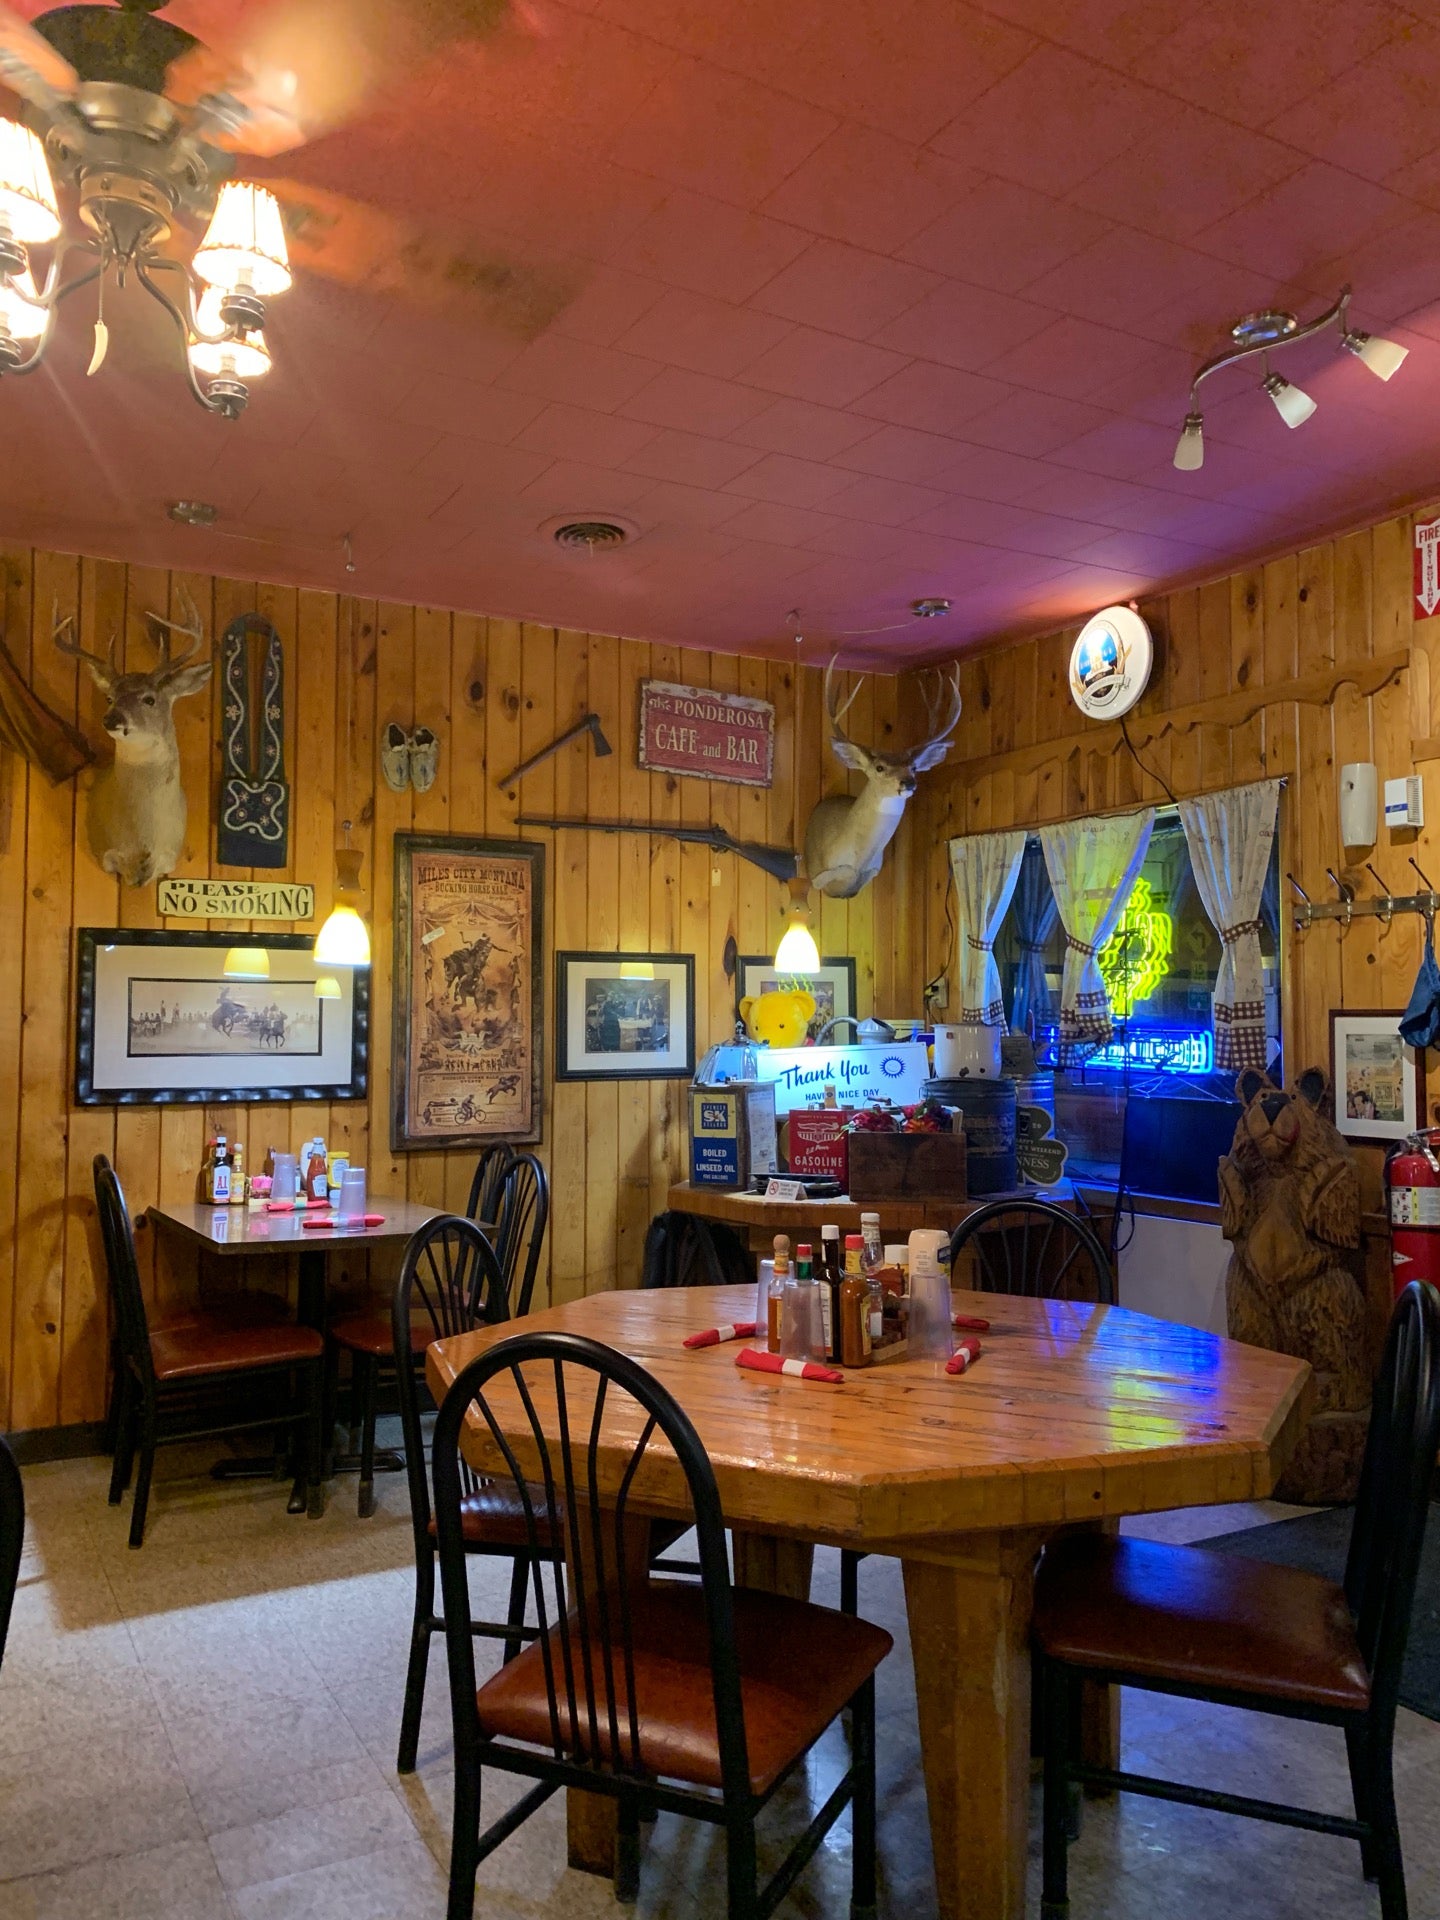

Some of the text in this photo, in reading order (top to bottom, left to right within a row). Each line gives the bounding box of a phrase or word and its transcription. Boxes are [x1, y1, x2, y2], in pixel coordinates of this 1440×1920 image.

[1418, 525, 1440, 543] FIRE
[674, 700, 765, 729] PONDEROSA
[655, 723, 759, 765] CAFE and BAR
[418, 866, 525, 891] MILES CITY MONTANA
[170, 882, 260, 897] PLEASE
[163, 887, 309, 917] NO SMOKING
[780, 1059, 870, 1090] Thank You
[838, 1089, 860, 1099] NICE
[863, 1088, 880, 1097] DAY
[702, 1148, 728, 1158] BOILED
[794, 1155, 843, 1167] GASOLINE
[696, 1162, 736, 1173] LINSEED OIL
